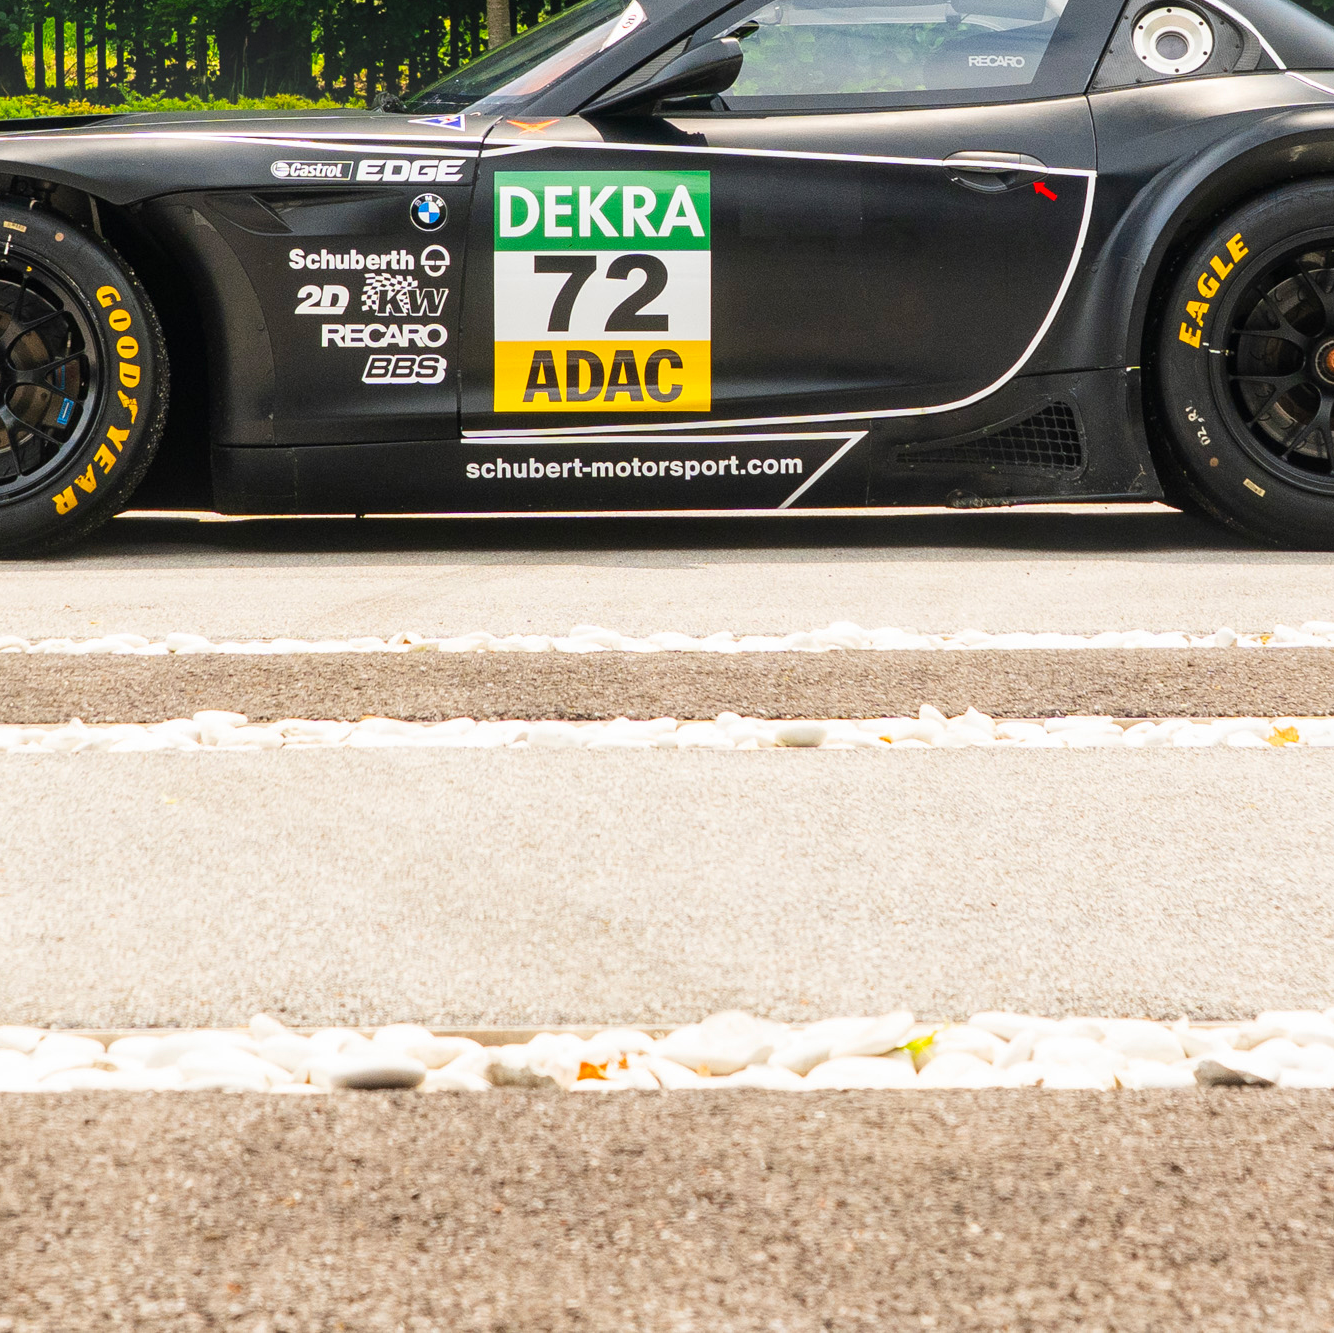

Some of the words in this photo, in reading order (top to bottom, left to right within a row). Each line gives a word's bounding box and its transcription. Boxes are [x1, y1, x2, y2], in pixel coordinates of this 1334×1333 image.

[968, 55, 1025, 68] RECARO
[290, 162, 342, 178] Castrol
[356, 159, 467, 182] EDGE
[499, 184, 705, 237] DEKRA
[289, 248, 415, 270] Schuberth
[294, 285, 350, 314] 2D
[374, 288, 449, 316] KW
[534, 254, 669, 332] 72
[1178, 232, 1249, 349] EAGLE
[322, 324, 448, 347] RECARO
[362, 354, 447, 384] BBS
[523, 349, 684, 403] ADAC
[466, 455, 803, 480] schubert-motorsport.com
